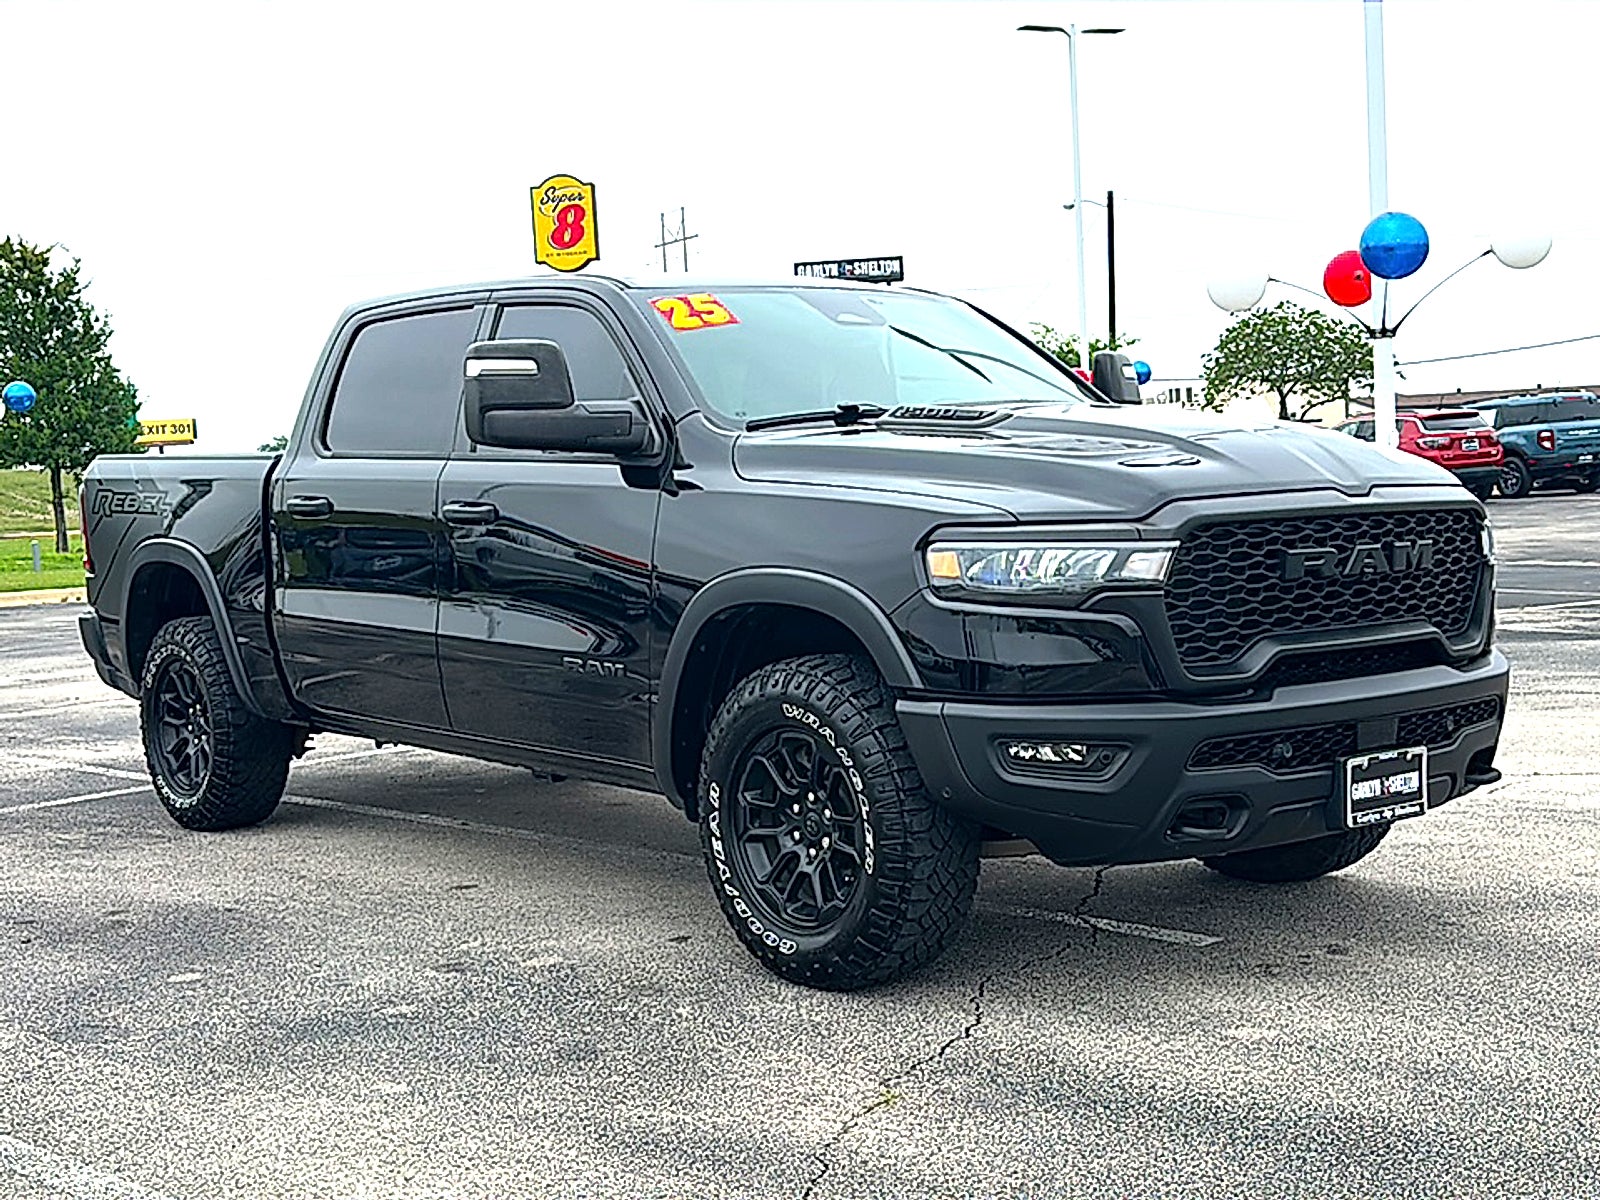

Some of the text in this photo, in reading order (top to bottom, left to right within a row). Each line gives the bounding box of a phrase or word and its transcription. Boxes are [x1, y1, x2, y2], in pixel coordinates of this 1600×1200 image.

[540, 186, 585, 213] Super
[550, 204, 586, 250] 8
[797, 259, 900, 278] GARLYN SHELTON
[655, 293, 730, 329] 25
[170, 423, 191, 435] 301
[1279, 539, 1433, 580] RAM
[562, 656, 625, 677] RAM
[709, 782, 797, 954] GOODYEAR
